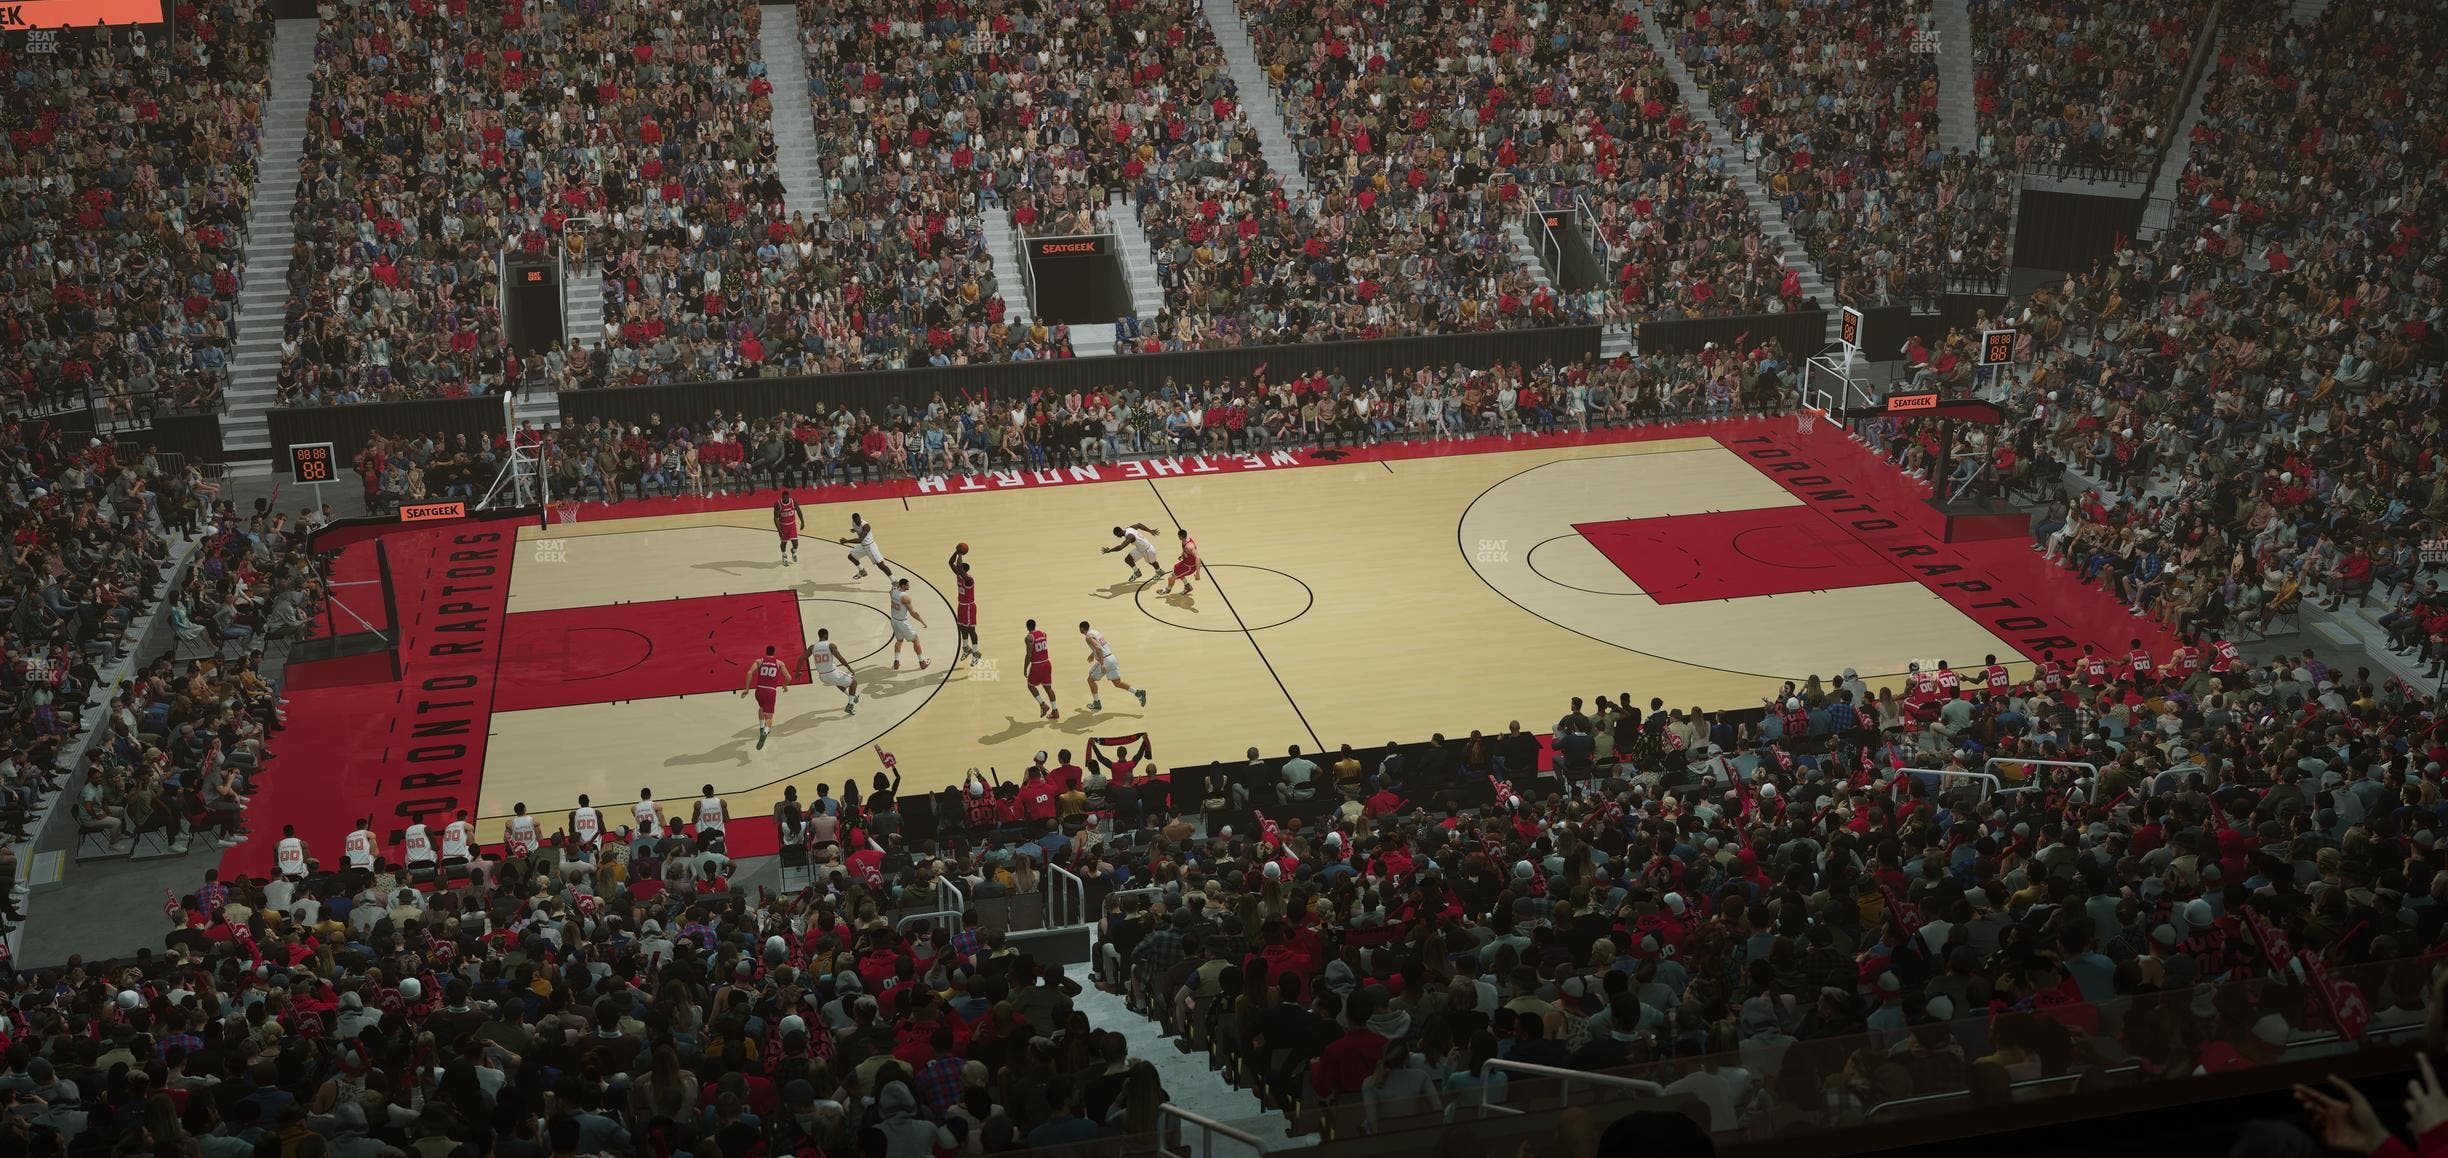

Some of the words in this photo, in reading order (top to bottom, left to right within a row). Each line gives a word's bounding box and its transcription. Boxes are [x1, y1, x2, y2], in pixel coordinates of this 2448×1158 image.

[1041, 242, 1096, 254] SEATGEEK
[1990, 345, 2008, 361] 88
[1894, 397, 1932, 409] SEATGEEK
[302, 461, 326, 480] 88
[1119, 454, 1219, 478] THE
[1732, 436, 1898, 531] TORONTO
[406, 505, 459, 519] SEATGEEK
[428, 532, 501, 657] RAPTORS
[2089, 665, 2105, 675] 00
[2133, 660, 2150, 670] 00
[760, 666, 778, 678] 00
[1939, 676, 1958, 687] 00
[1991, 675, 2008, 686] 00
[1035, 794, 1048, 804] 00
